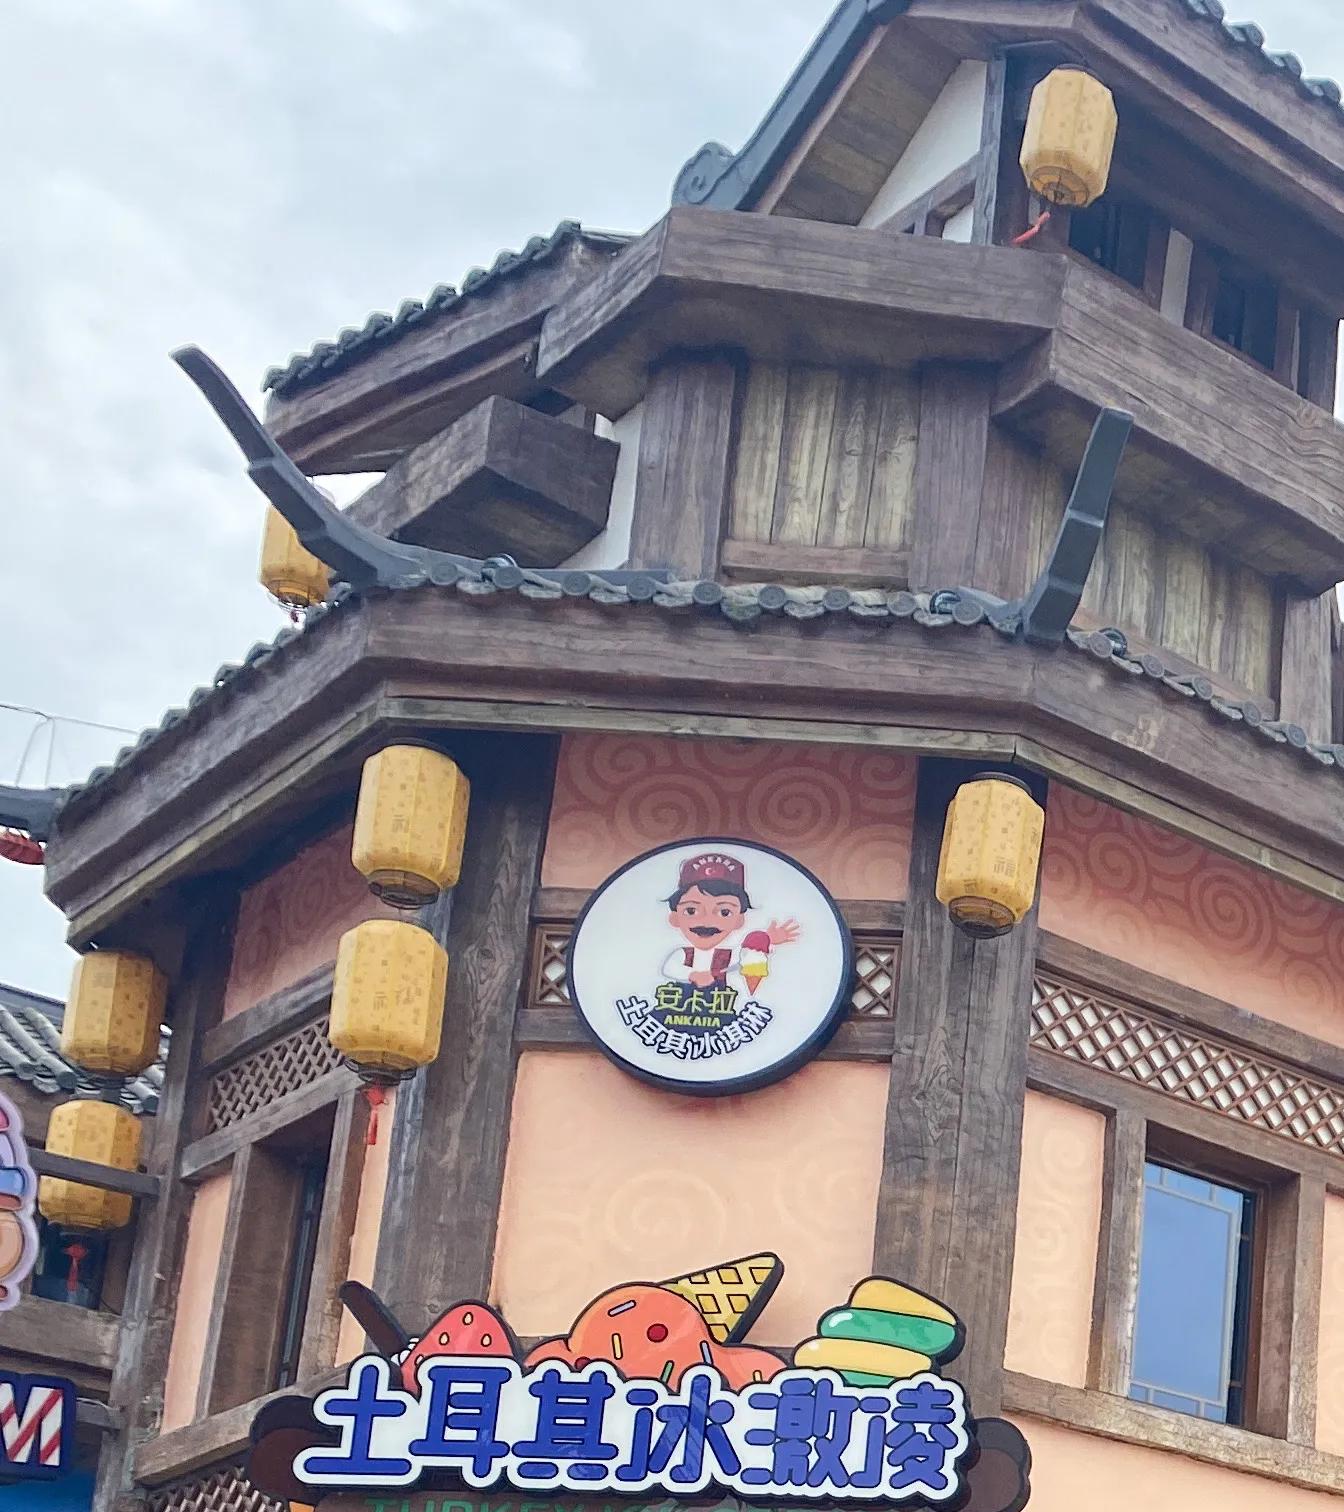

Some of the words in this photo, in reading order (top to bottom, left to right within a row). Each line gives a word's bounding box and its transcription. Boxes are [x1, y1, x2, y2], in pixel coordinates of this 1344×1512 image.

[616, 996, 773, 1059] 土耳其冰淇淋
[655, 982, 738, 1015] 安卡拉
[304, 1364, 958, 1490] 土耳其冰激凌
